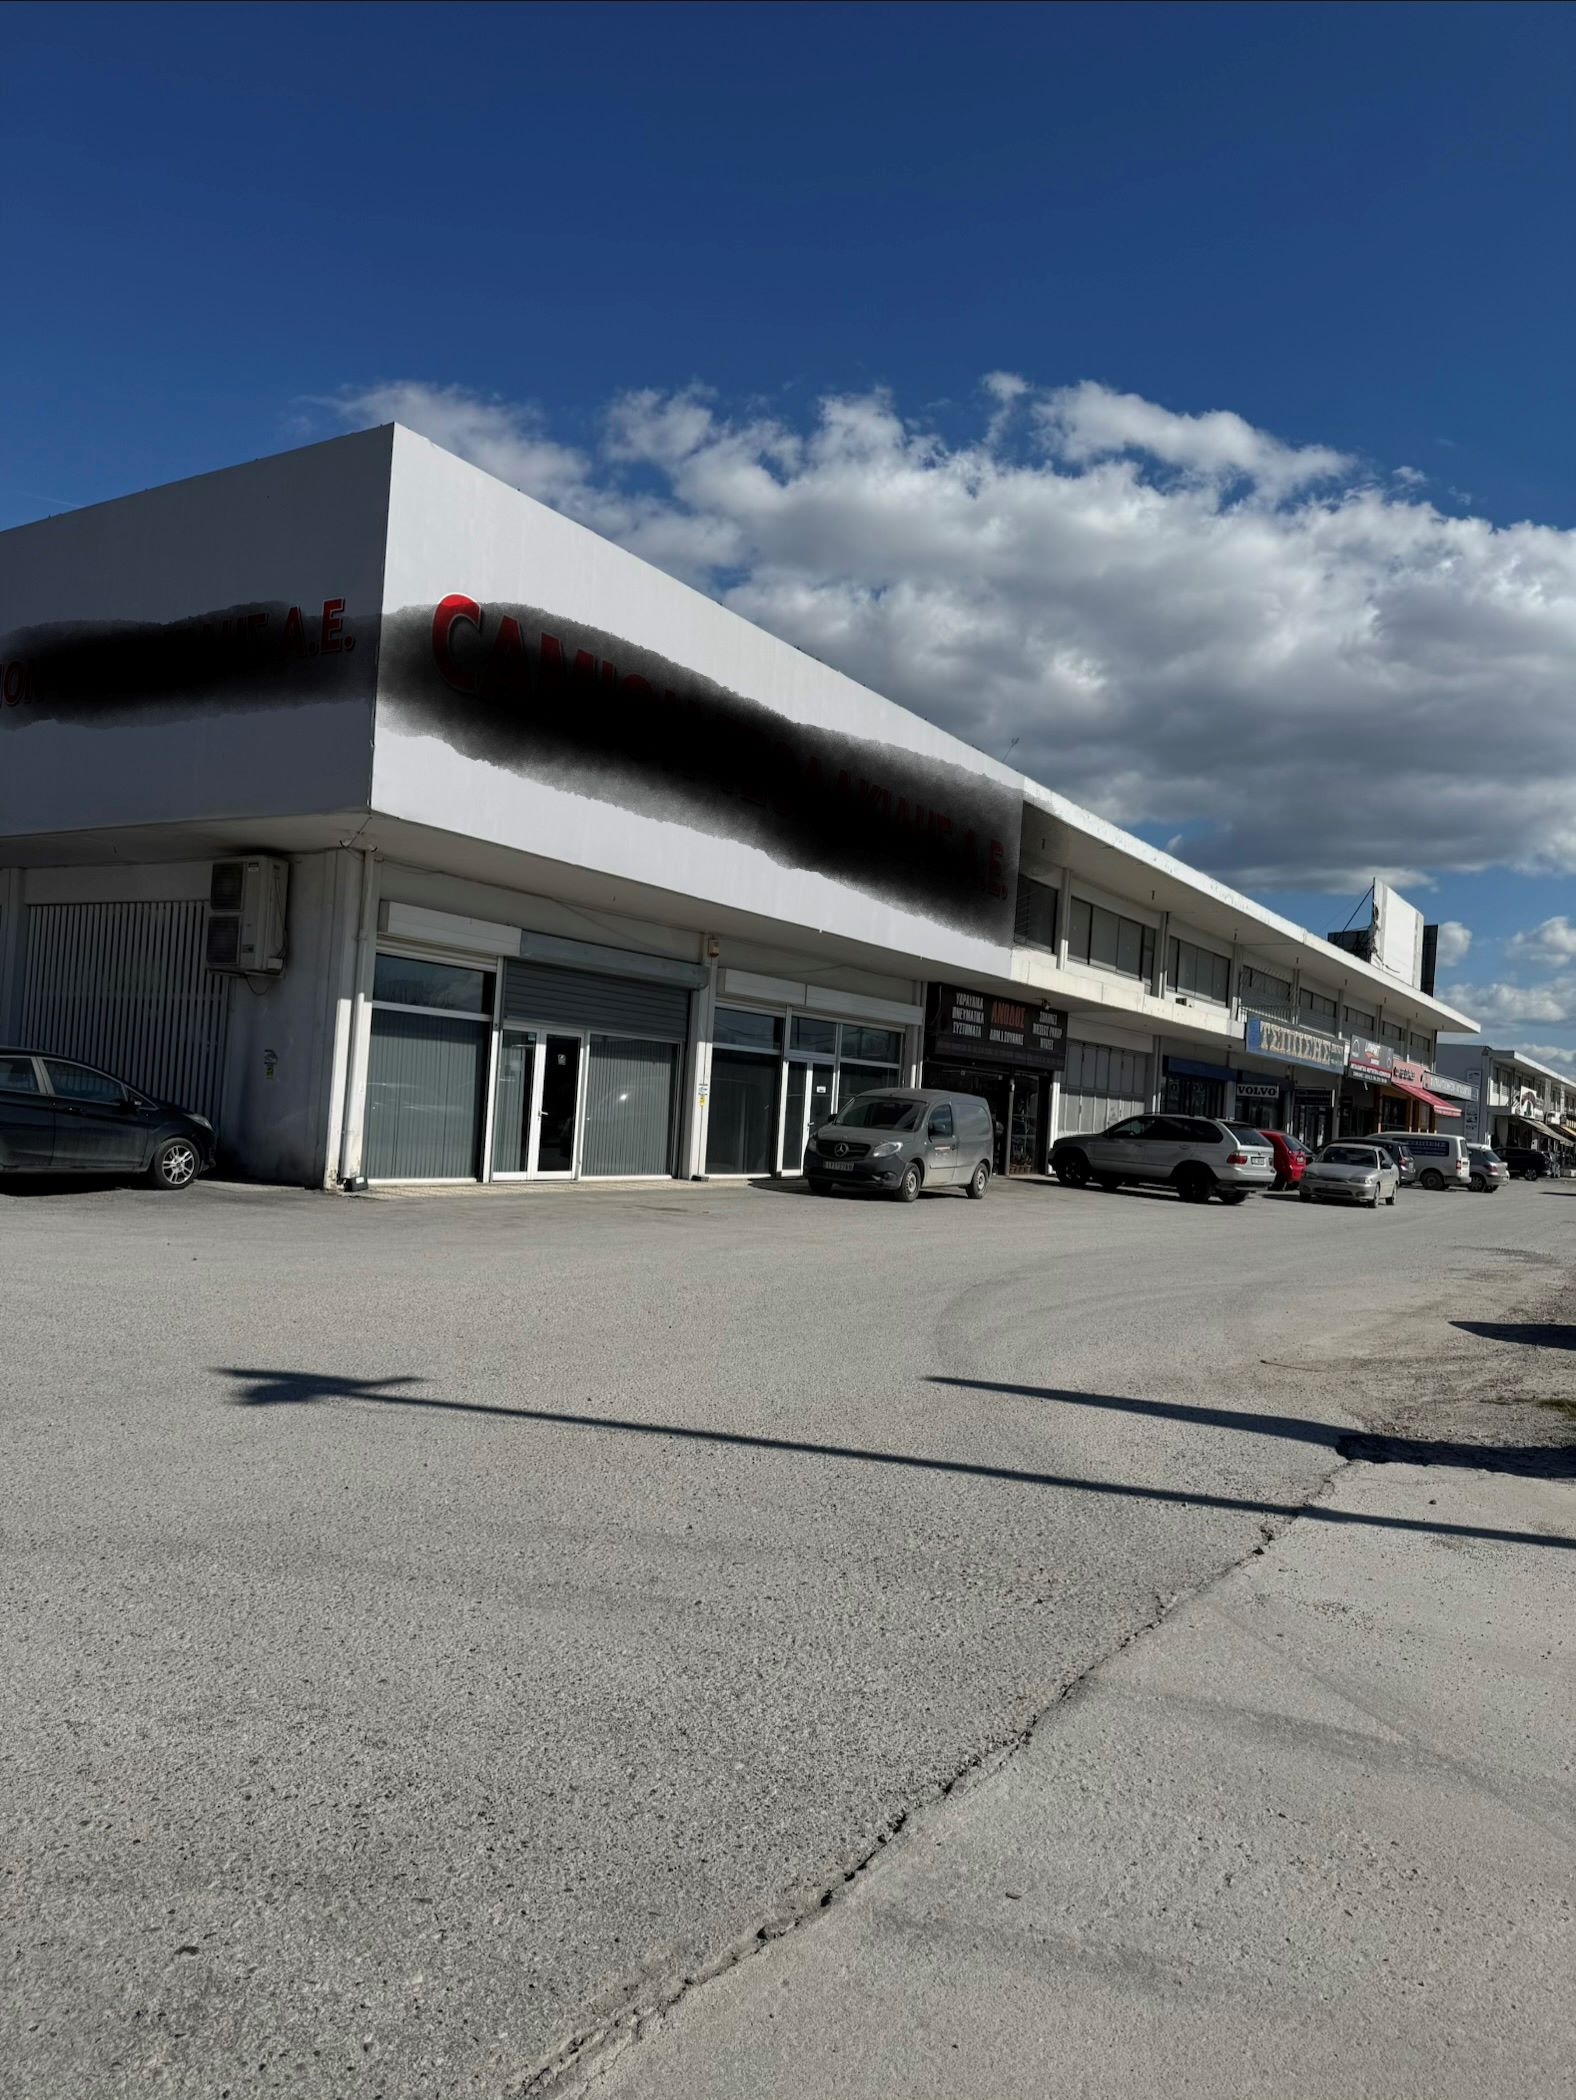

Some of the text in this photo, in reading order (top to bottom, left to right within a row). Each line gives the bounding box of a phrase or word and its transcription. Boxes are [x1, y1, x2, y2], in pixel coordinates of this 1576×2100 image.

[952, 1006, 985, 1025] ΠΝΕΥΜΑΤΙΚΑ
[991, 1001, 1025, 1029] ΑΝΟΔΟΣ
[952, 1021, 982, 1038] ΣΥΣΤΗΜΑΤΑ
[1238, 1086, 1277, 1096] VOLVO
